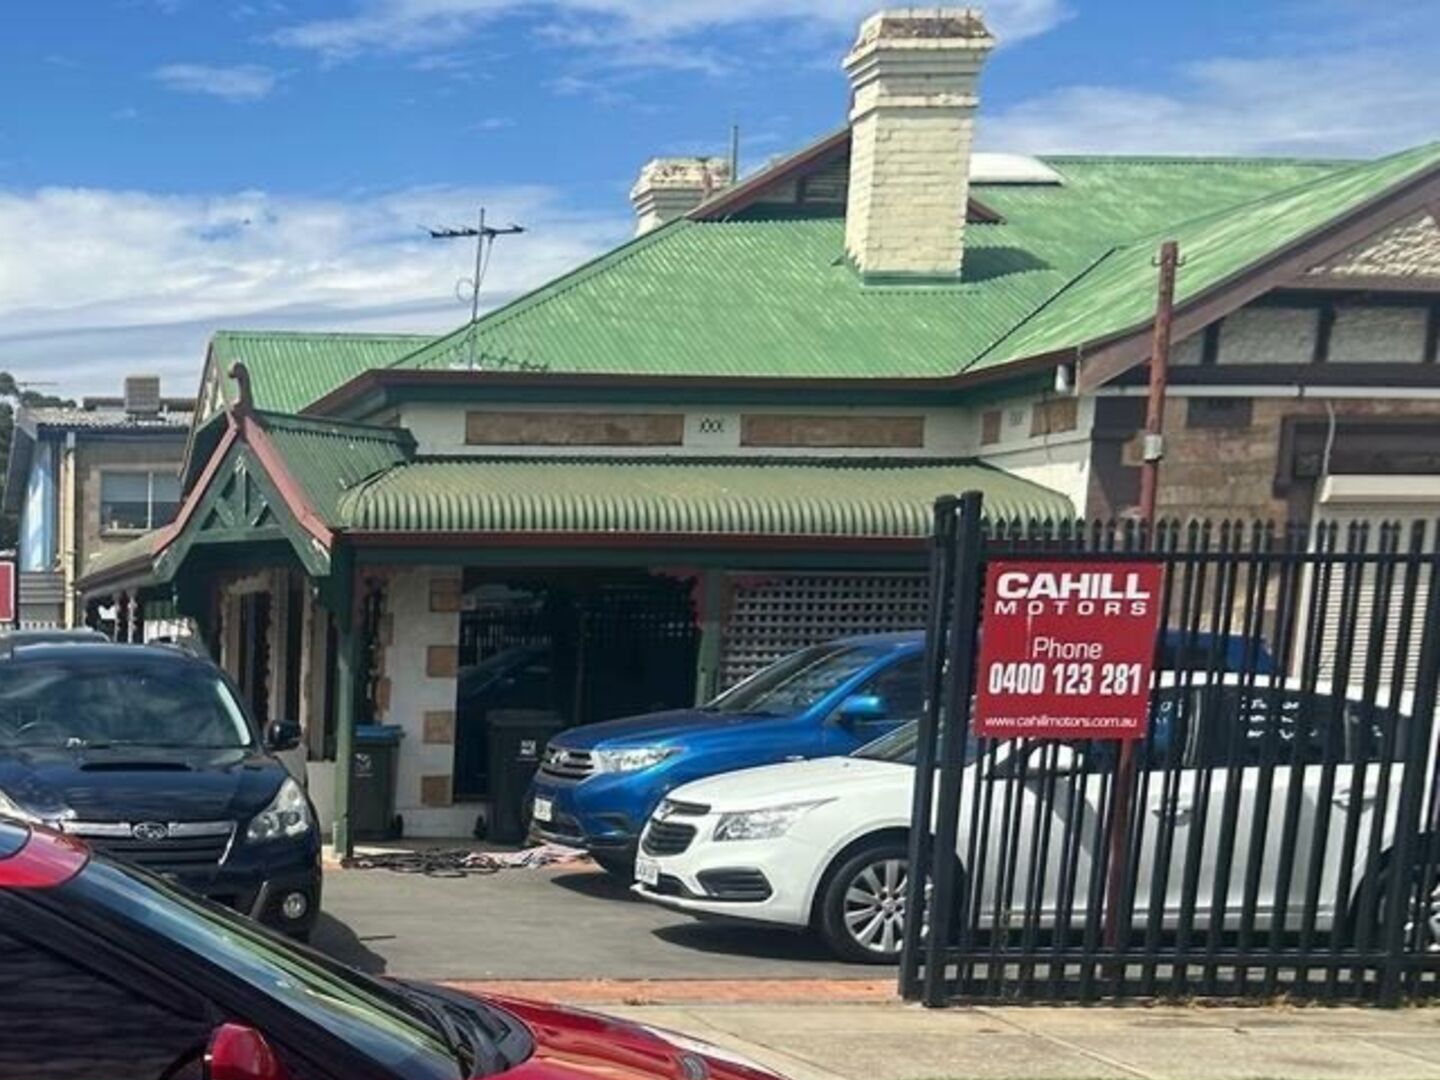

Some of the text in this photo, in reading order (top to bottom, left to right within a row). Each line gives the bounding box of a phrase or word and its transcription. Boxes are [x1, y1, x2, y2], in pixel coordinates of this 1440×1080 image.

[996, 572, 1150, 599] CAHILL
[994, 601, 1147, 616] MOTORS
[1033, 636, 1102, 659] Phone
[988, 662, 1142, 695] 0400 123 281
[985, 714, 1137, 728] www.cahillmotors.com.au
